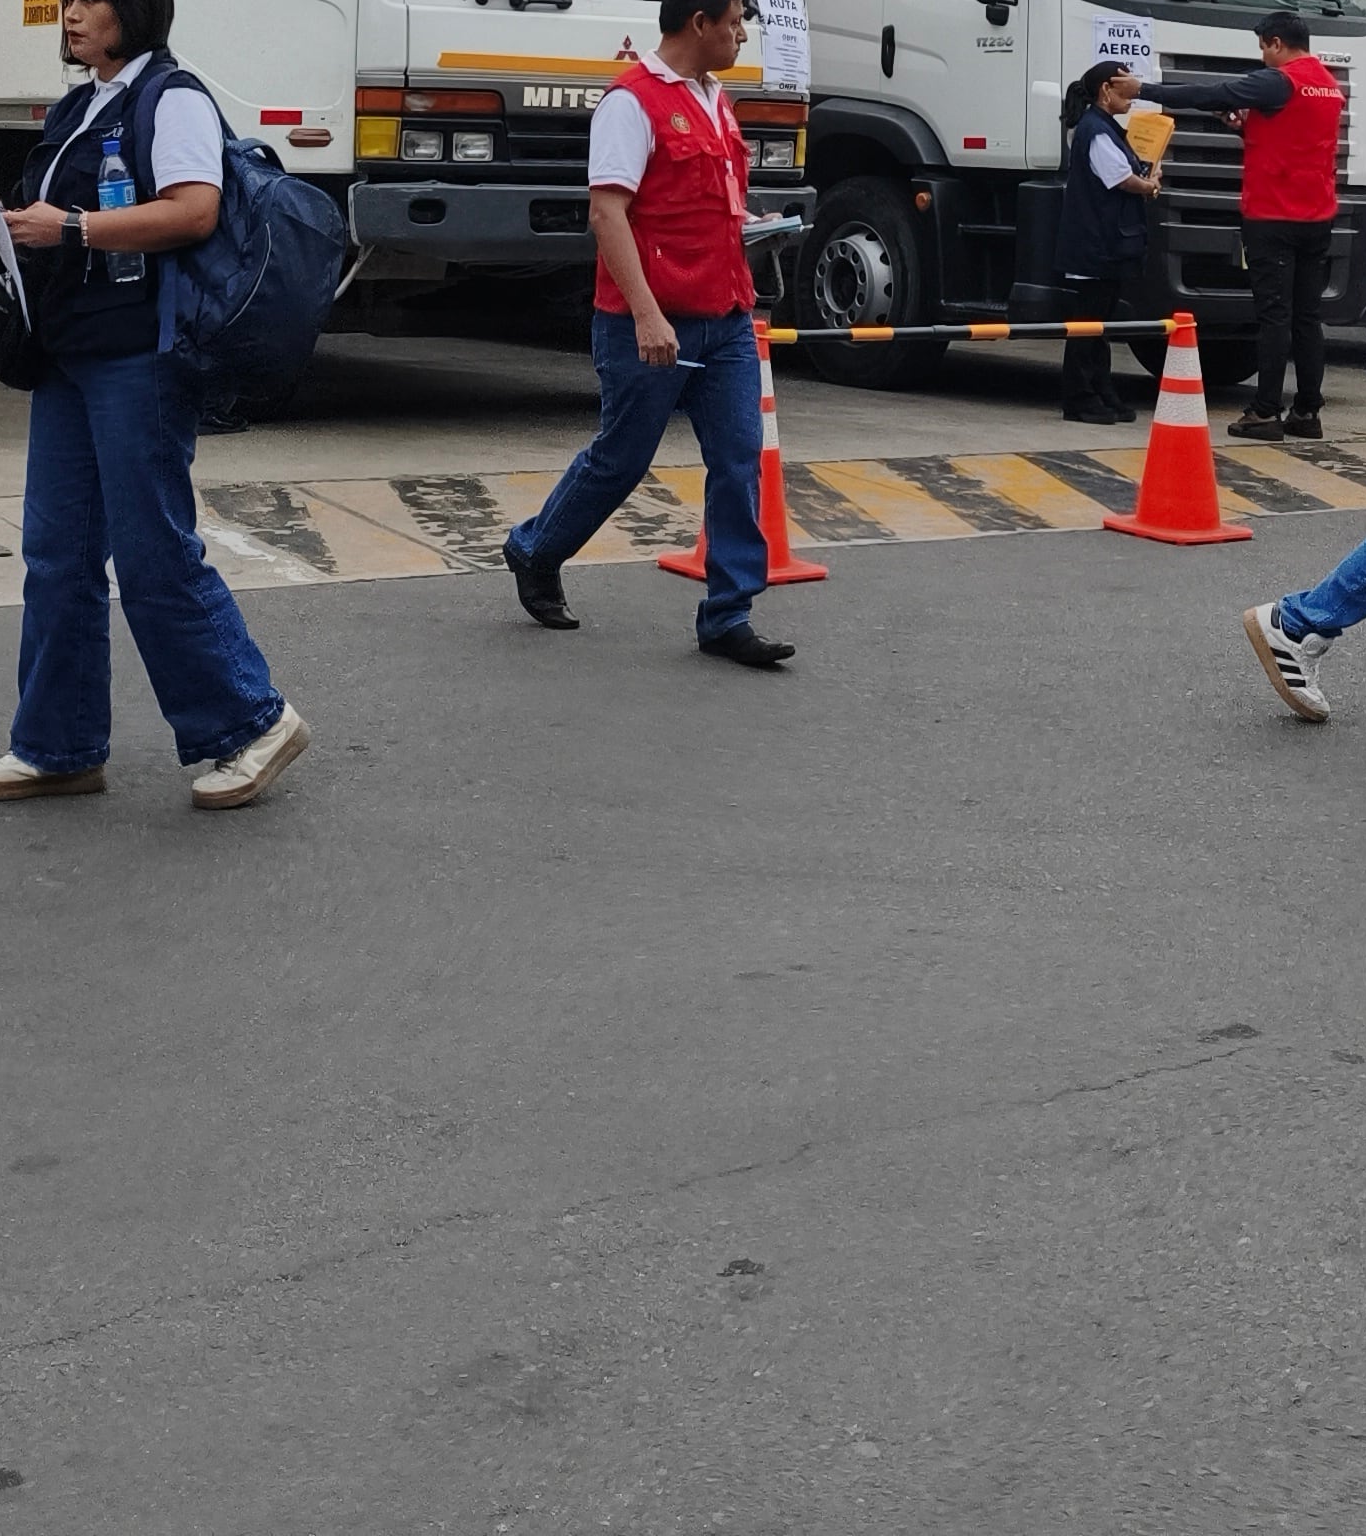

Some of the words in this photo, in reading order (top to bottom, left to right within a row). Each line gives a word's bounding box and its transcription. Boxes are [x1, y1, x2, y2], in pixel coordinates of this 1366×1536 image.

[767, 13, 807, 32] AEREO
[1108, 27, 1141, 39] RUTA
[1098, 42, 1151, 57] AEREO
[523, 86, 606, 110] MITS
